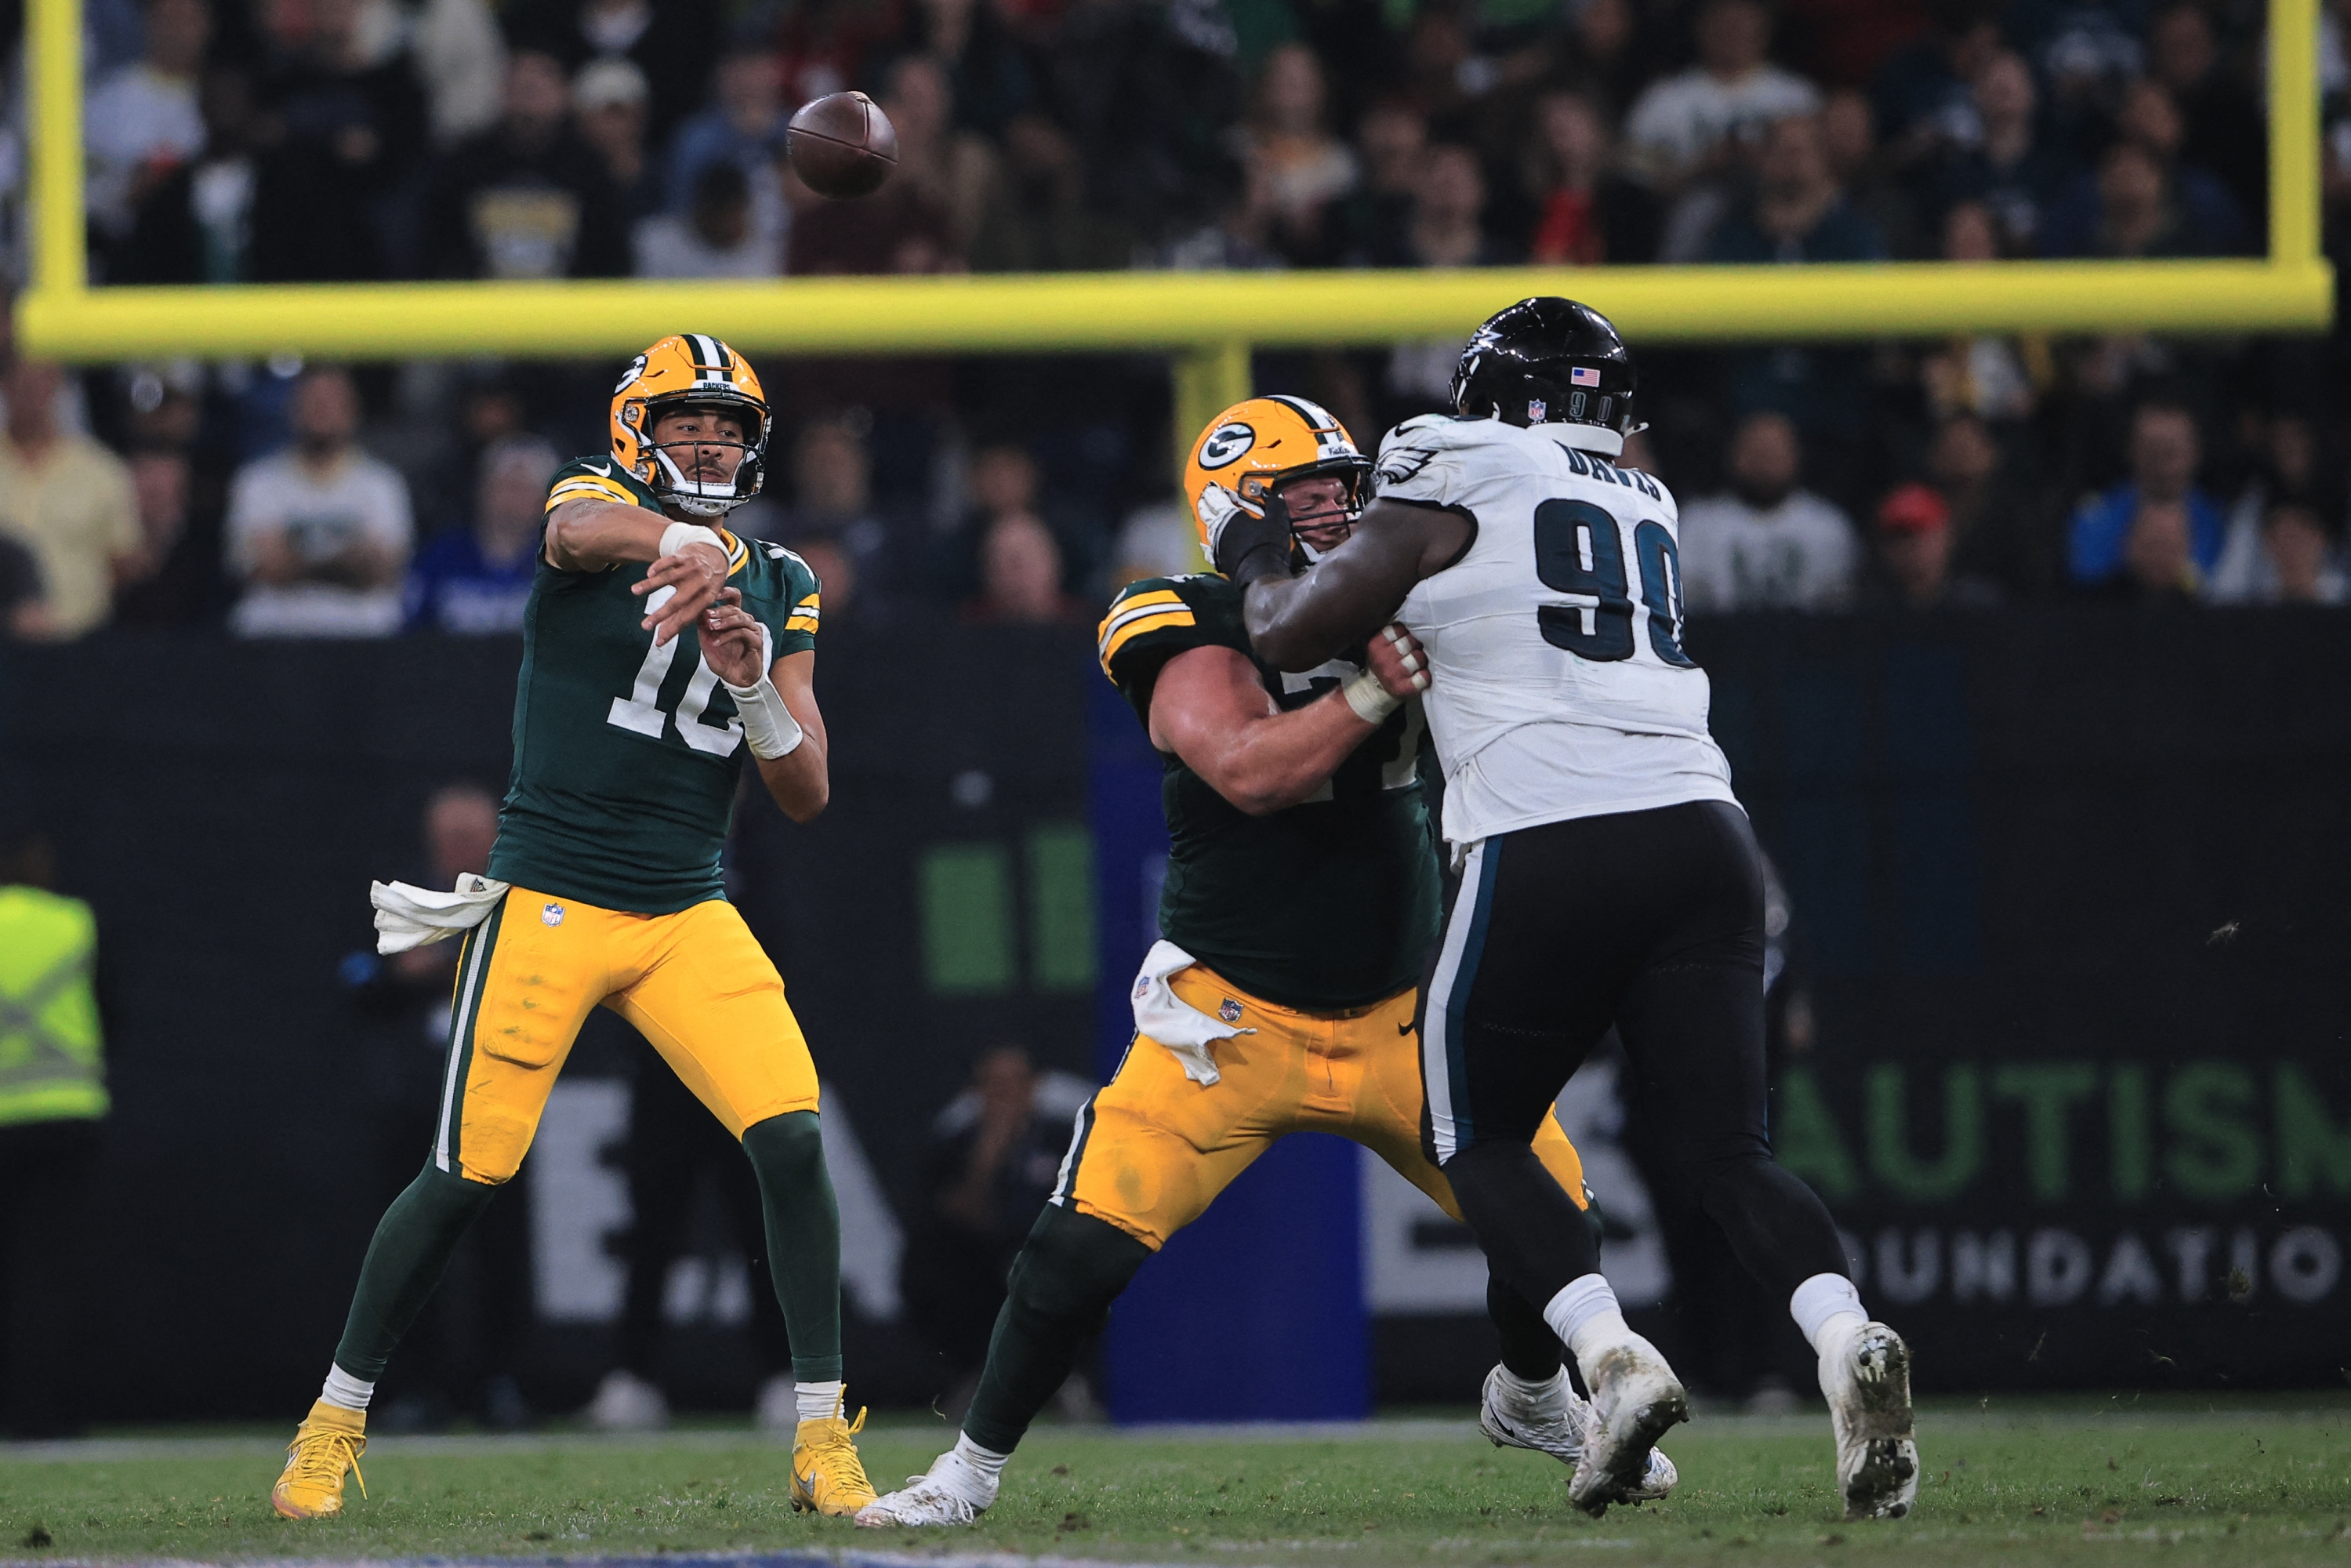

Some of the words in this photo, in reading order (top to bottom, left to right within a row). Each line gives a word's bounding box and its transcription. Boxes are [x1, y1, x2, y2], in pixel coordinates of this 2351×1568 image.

[702, 382, 731, 390] PACKERS
[1569, 391, 1613, 422] 90
[1553, 439, 1661, 501] DAVIS
[1534, 497, 1698, 668] 90
[607, 584, 774, 758] 10
